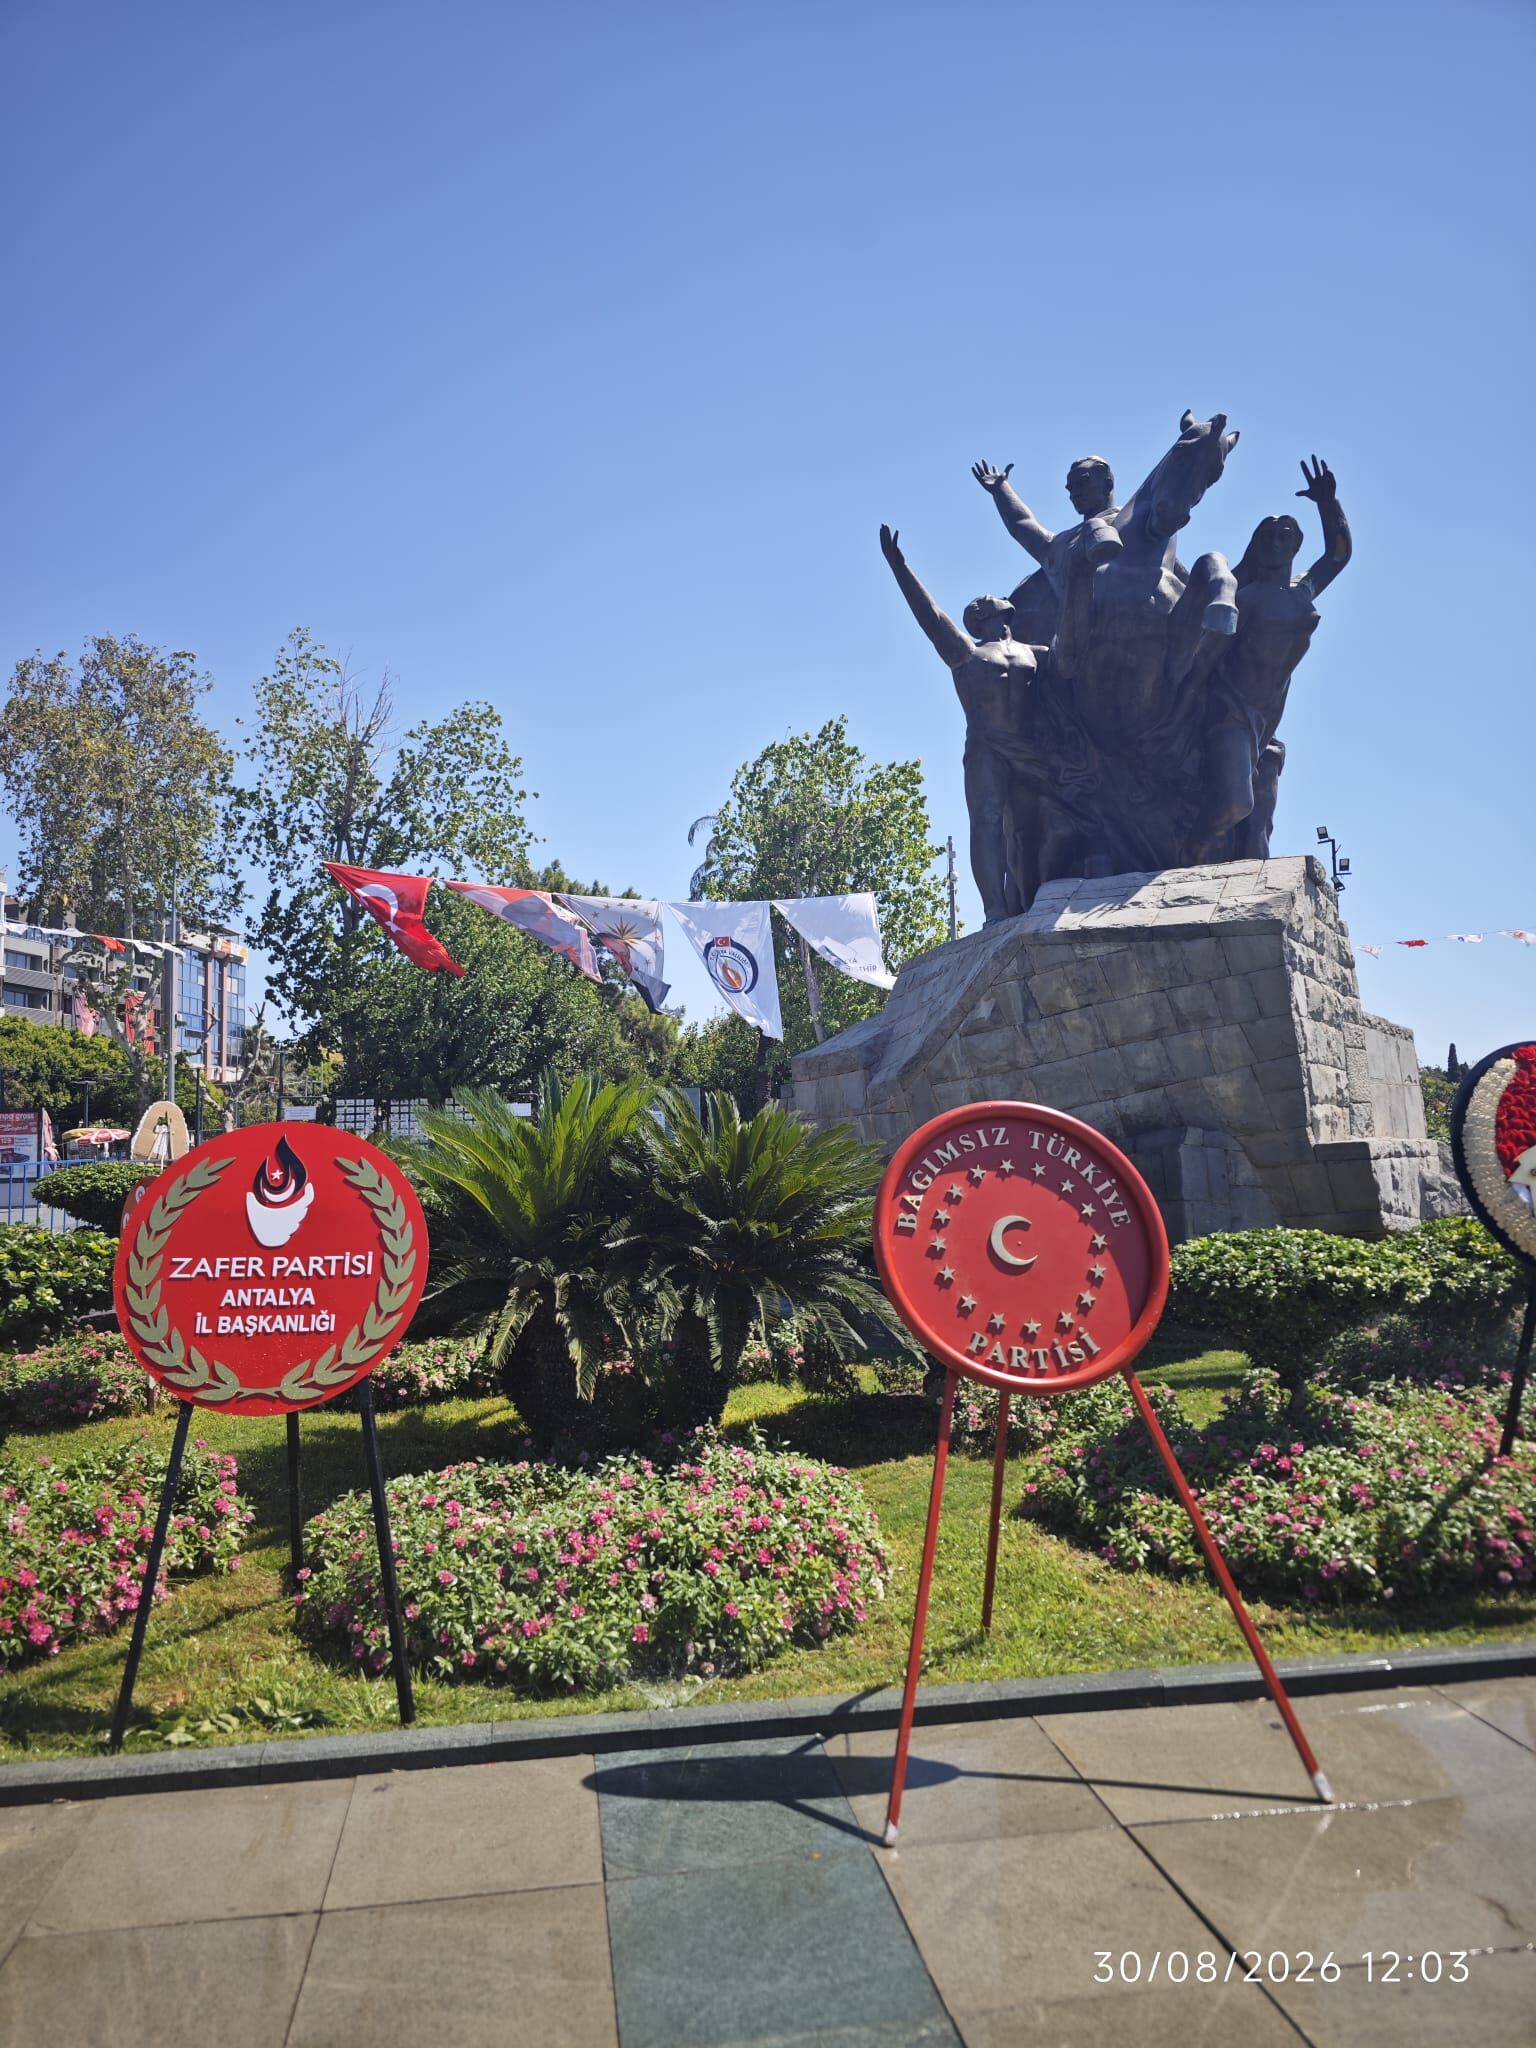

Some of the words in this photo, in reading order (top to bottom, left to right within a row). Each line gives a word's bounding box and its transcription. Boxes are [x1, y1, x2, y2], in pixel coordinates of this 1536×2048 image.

[15, 1113, 34, 1121] gross
[897, 1127, 1010, 1231] BAĞIMSIZ
[1028, 1130, 1132, 1228] TÜRKİYE
[169, 1256, 266, 1279] ZAFER
[271, 1251, 374, 1277] PARTİSİ
[220, 1287, 316, 1307] ANTALYA
[195, 1312, 213, 1334] İL
[217, 1309, 336, 1337] BAŞKANLIĞI
[967, 1326, 1101, 1370] PARTİSİ
